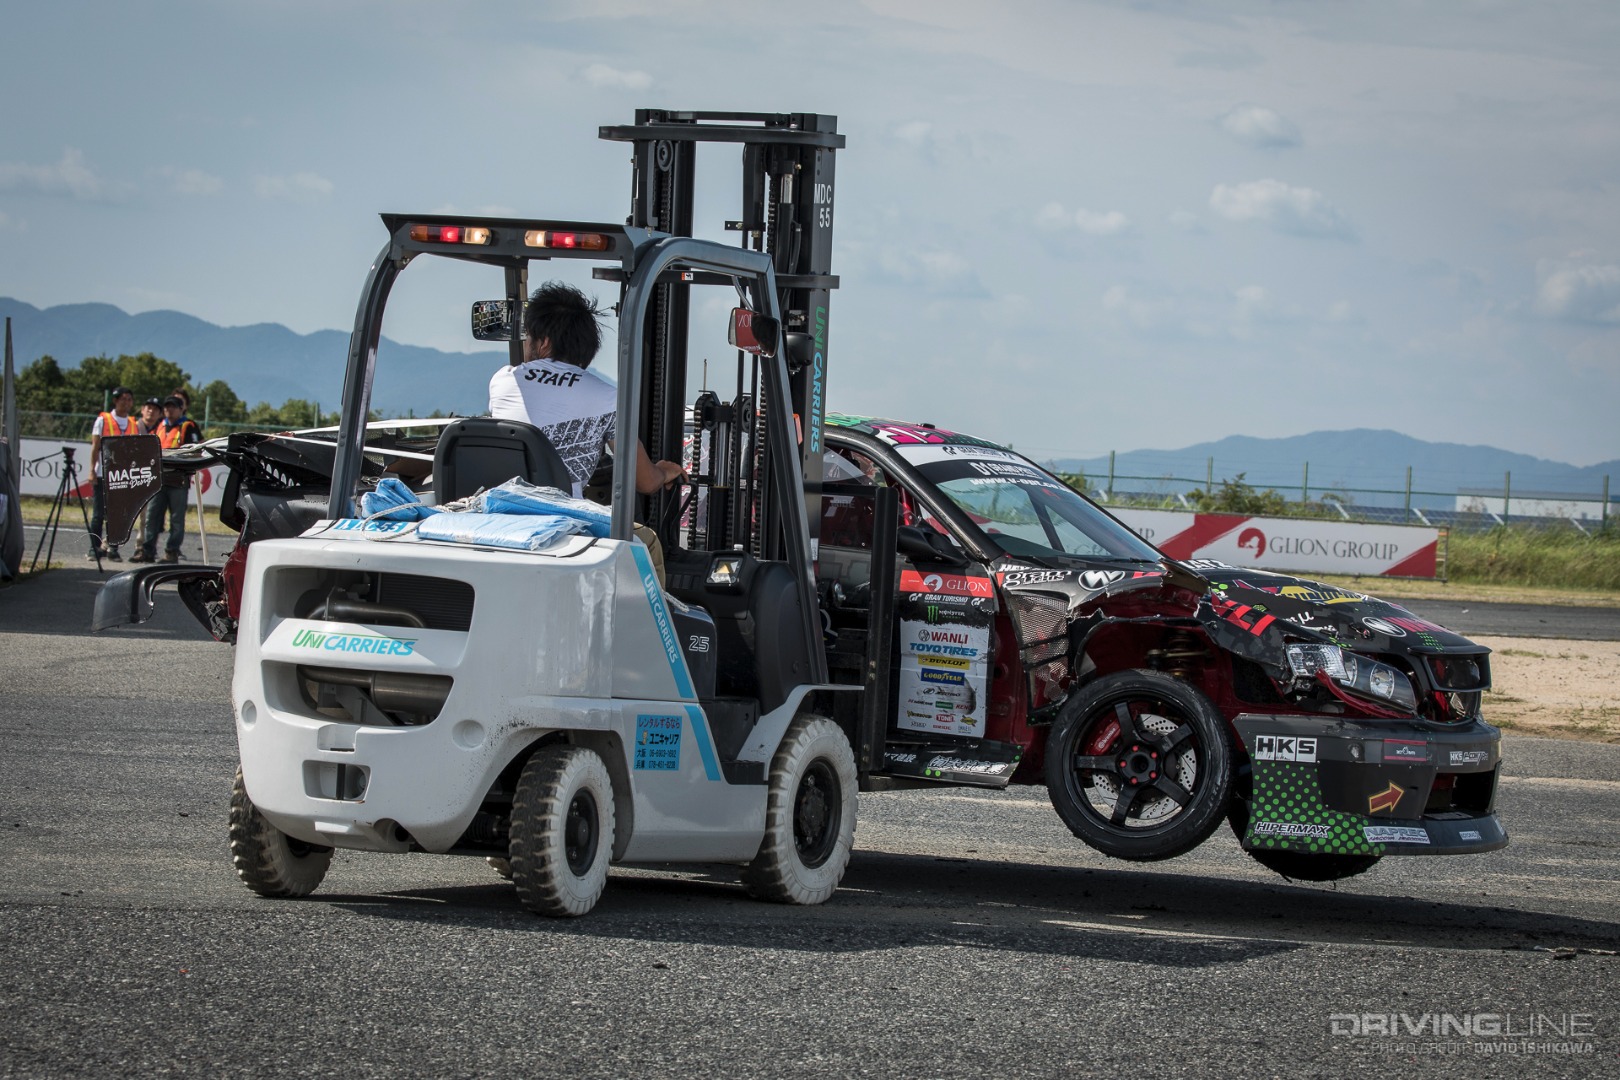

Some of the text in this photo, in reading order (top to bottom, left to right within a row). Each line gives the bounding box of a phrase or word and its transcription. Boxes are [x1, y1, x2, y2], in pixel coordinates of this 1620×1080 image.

[813, 183, 832, 205] MDC
[819, 207, 831, 228] 55
[524, 368, 583, 388] STAFF
[811, 306, 827, 454] UNICARRIERS
[21, 459, 83, 480] ROUP
[108, 466, 152, 482] MACS
[129, 475, 157, 489] Design
[1269, 536, 1399, 561] GLION GROUP
[946, 579, 988, 593] GLION
[924, 593, 941, 601] GRAN
[942, 595, 969, 603] TURISMO
[643, 573, 679, 664] UNICARRIERS
[292, 629, 418, 656] UNICARRIERS
[688, 635, 710, 652] 25
[931, 631, 969, 645] WANLI
[910, 642, 978, 657] TOYO TIRES
[929, 658, 966, 667] DUNLOP
[923, 672, 962, 682] GOODYEAR
[649, 733, 680, 745] ユニキャリア
[1257, 737, 1316, 755] HKS
[1450, 752, 1463, 761] HKS
[1256, 821, 1331, 836] HIPERMAX
[1364, 827, 1428, 838] NAPREC
